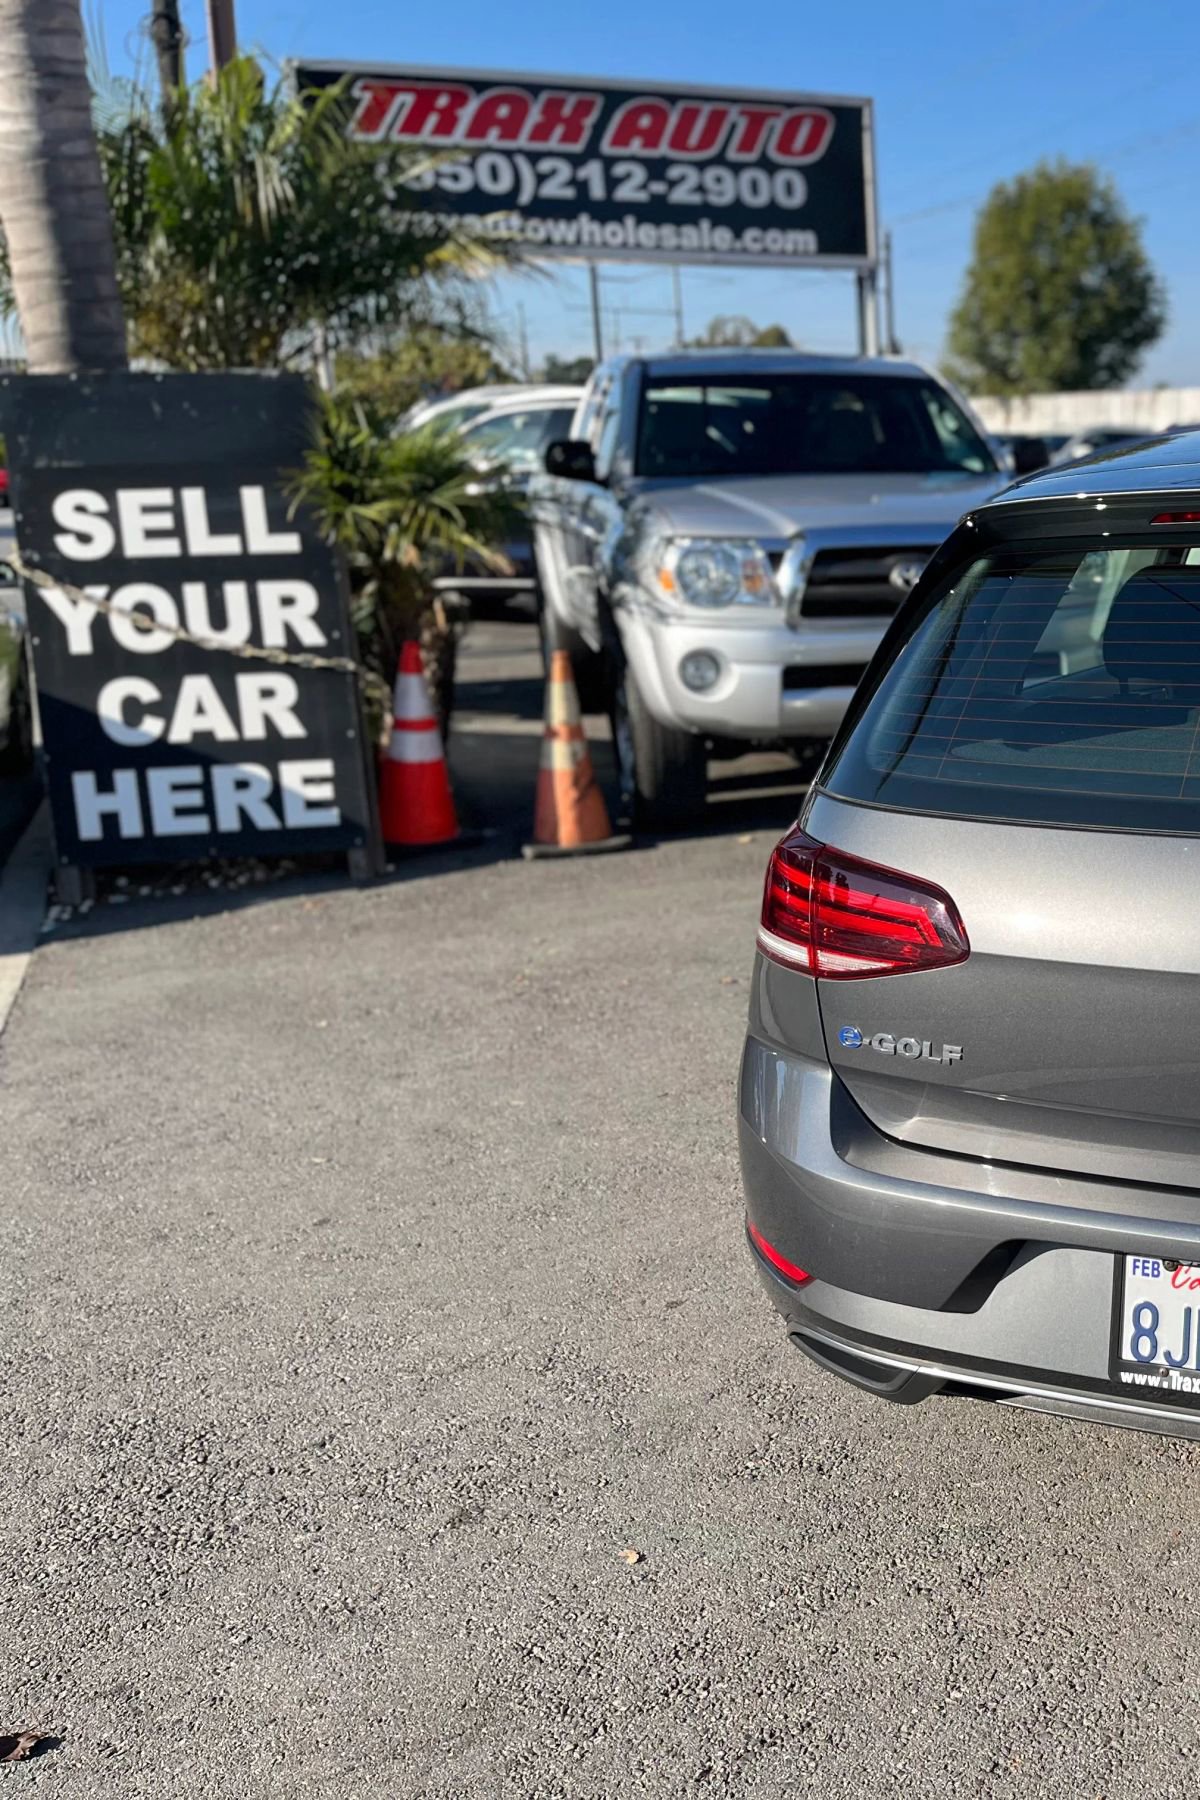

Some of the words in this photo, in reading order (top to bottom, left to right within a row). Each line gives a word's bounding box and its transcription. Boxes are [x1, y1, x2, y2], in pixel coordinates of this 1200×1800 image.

[349, 79, 603, 153] TRAX
[600, 98, 834, 165] AUTO
[51, 485, 302, 561] SELL
[38, 580, 327, 655] YOUR
[98, 671, 307, 746] CAR
[71, 759, 341, 840] HERE
[1132, 1258, 1161, 1278] FEB
